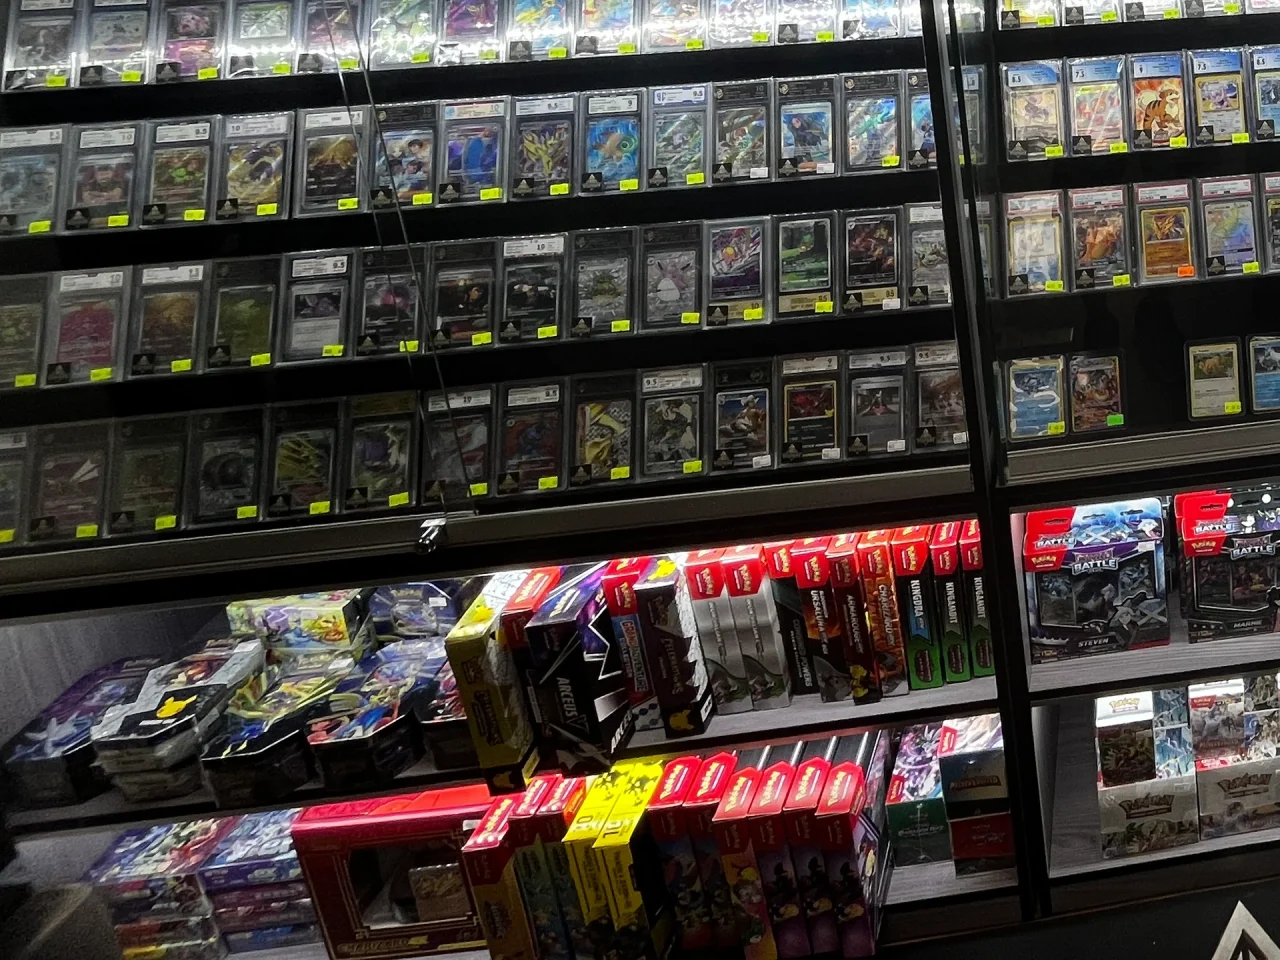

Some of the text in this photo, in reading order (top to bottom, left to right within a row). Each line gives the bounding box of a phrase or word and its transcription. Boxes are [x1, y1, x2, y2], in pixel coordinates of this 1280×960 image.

[1195, 523, 1233, 533] BATTLE
[1036, 537, 1075, 547] BATTLE
[1232, 545, 1273, 557] BATTLE
[1074, 558, 1116, 572] BATTLE
[910, 579, 924, 618] KINGDRA
[810, 589, 826, 635] URSALUNA
[1078, 637, 1109, 647] STEVEN
[556, 676, 579, 719] ARCEUS
